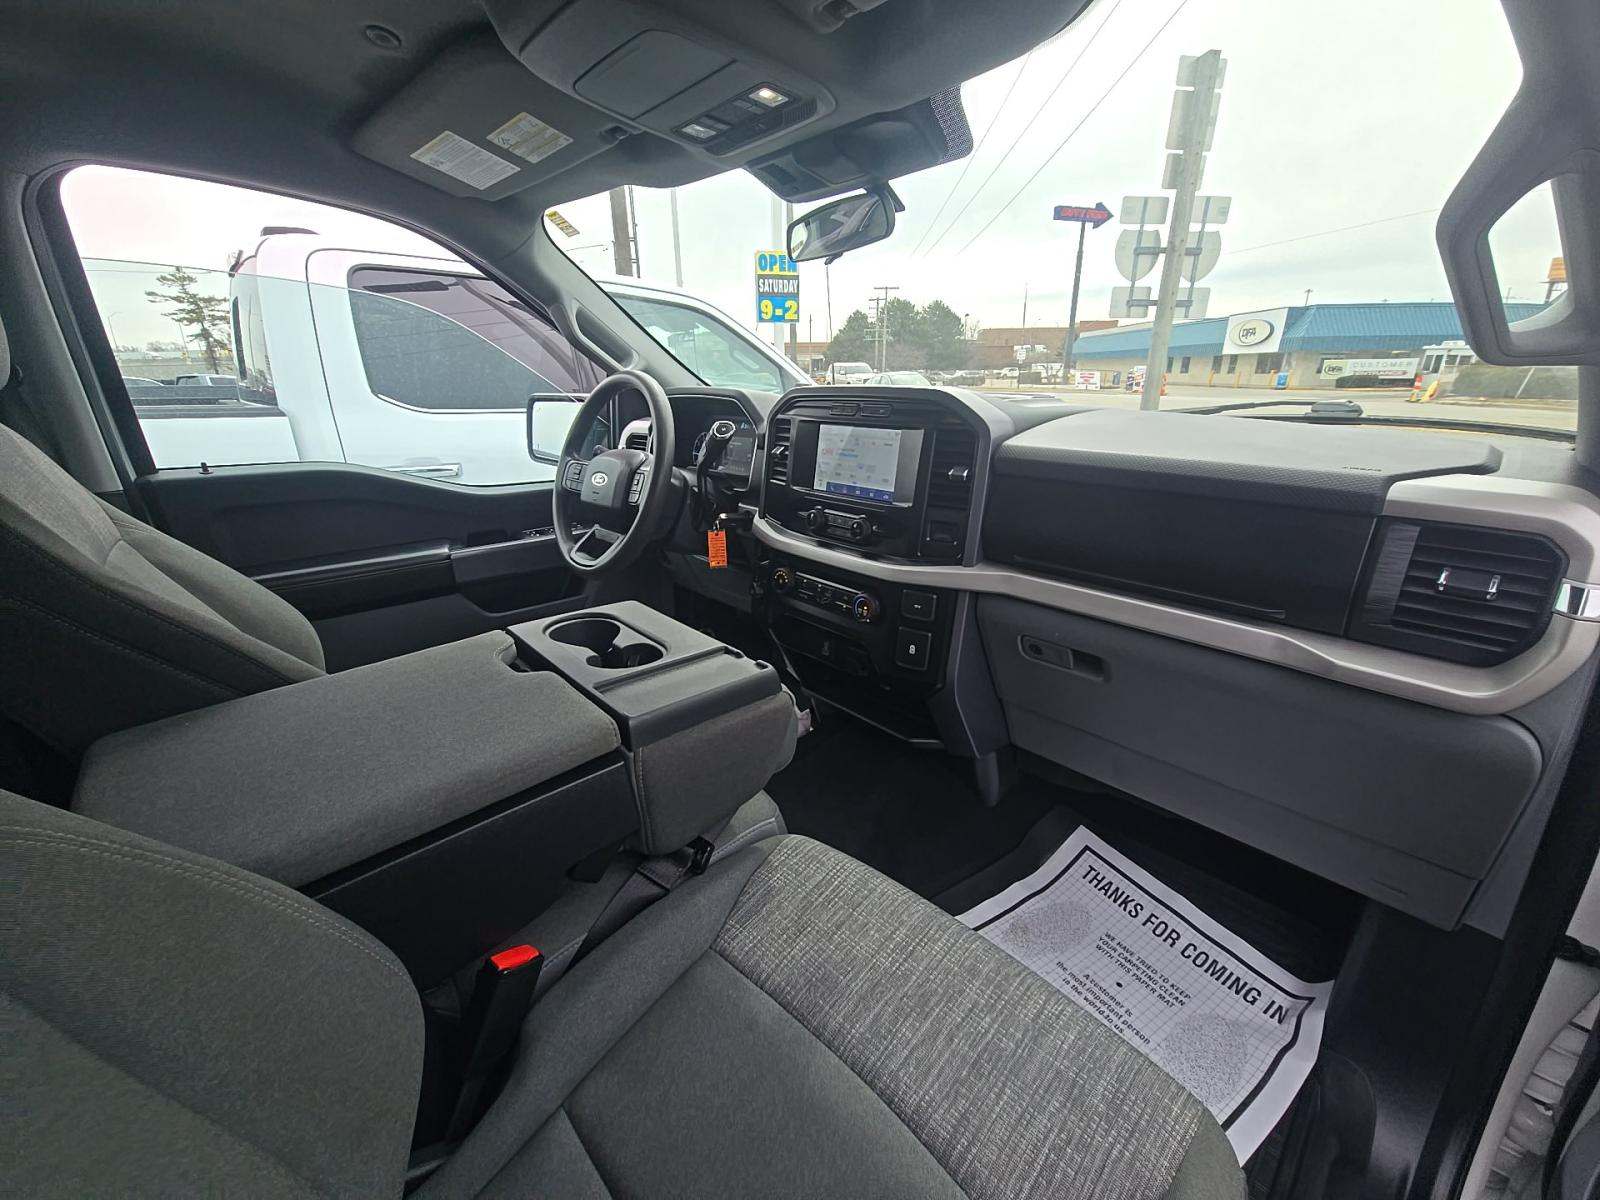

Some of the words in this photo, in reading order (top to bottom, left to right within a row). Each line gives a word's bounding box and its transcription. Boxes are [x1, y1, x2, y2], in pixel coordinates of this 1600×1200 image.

[757, 253, 798, 273] OPEN
[758, 278, 798, 293] SATURDAY
[760, 299, 799, 320] 9-2
[1082, 864, 1144, 919] THANKS
[1141, 912, 1181, 948] FOR
[1180, 942, 1262, 1006] COMING
[1262, 1000, 1289, 1025] IN
[1099, 936, 1118, 954] YOUR
[1117, 952, 1159, 986] CARPETING
[1158, 984, 1187, 1007] CLEAN
[1104, 931, 1117, 942] WE
[1116, 941, 1135, 957] HAVE
[1136, 955, 1158, 975] TRIED
[1159, 973, 1170, 984] TO
[1170, 982, 1192, 1000] KEEP
[1056, 961, 1069, 973] the
[1067, 971, 1087, 989] most
[1086, 986, 1124, 1020] important
[1121, 1019, 1152, 1046] person
[1083, 973, 1091, 981] A
[1124, 1007, 1134, 1018] is
[1095, 943, 1114, 960] WITH
[1114, 958, 1133, 974] THIS
[1131, 972, 1158, 995] PAPER
[1156, 993, 1176, 1009] MAT
[1070, 984, 1083, 996] the
[1083, 995, 1106, 1016] world
[1103, 1014, 1115, 1025] to
[1114, 1023, 1125, 1034] us
